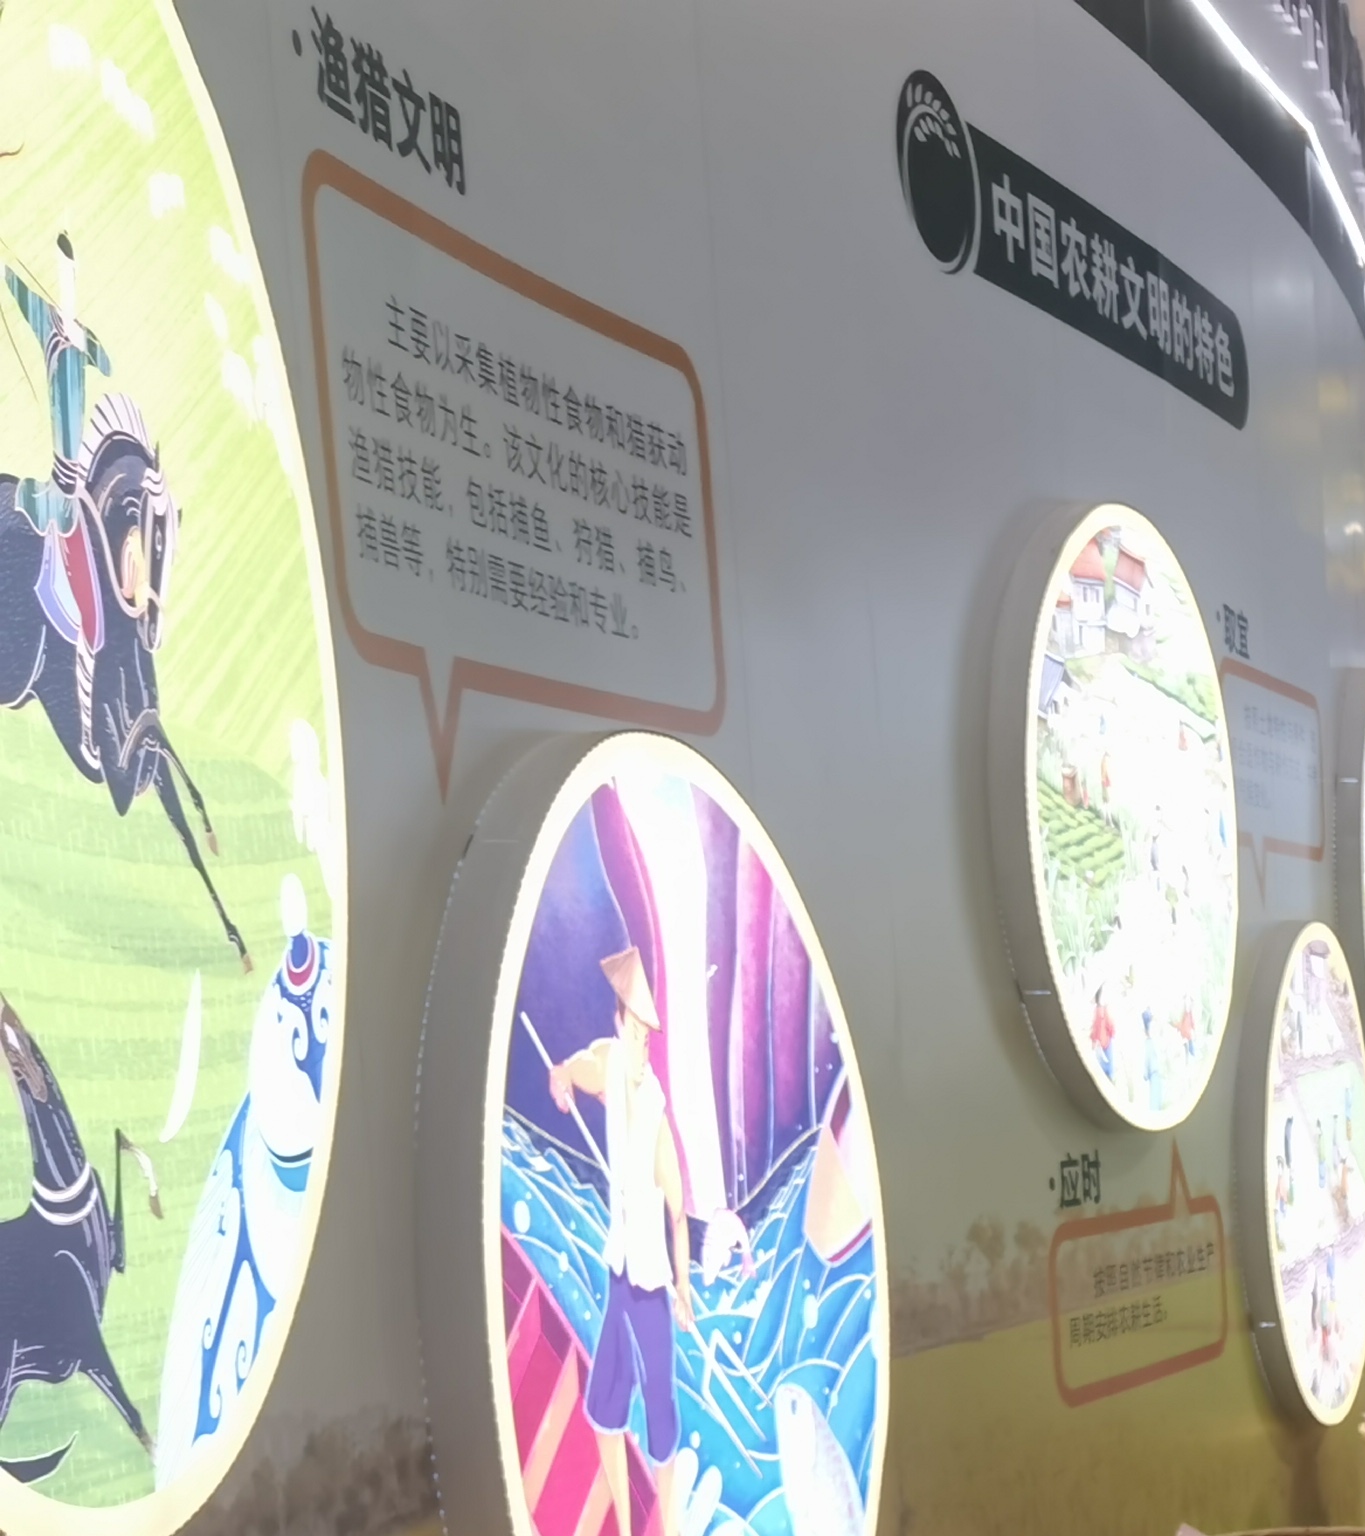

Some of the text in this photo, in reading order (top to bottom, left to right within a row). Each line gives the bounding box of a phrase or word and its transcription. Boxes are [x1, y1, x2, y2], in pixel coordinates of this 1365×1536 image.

[310, 9, 467, 196] 渔猎文明
[991, 173, 1235, 398] 中国农耕文明的特色
[1059, 1149, 1102, 1209] 应时
